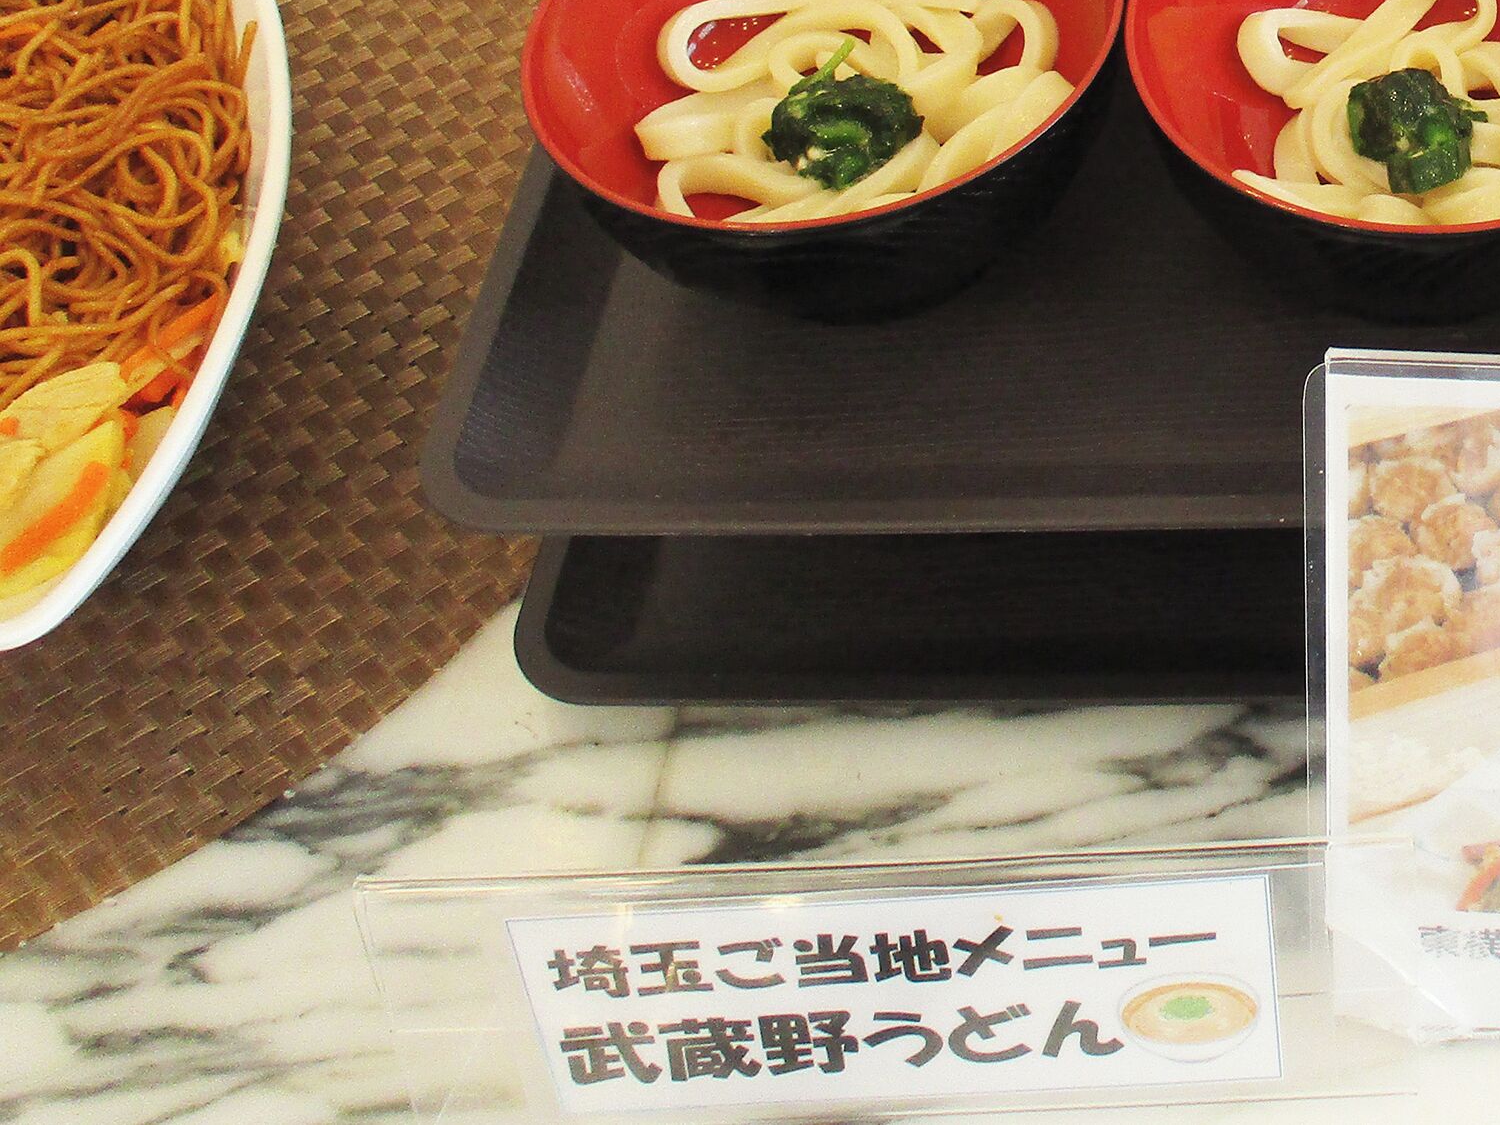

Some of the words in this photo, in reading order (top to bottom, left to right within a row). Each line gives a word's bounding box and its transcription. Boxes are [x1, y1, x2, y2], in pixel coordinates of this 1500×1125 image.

[547, 924, 1217, 998] 埼玉ご当地メニュー
[560, 999, 1125, 1085] 武蔵野うどん
